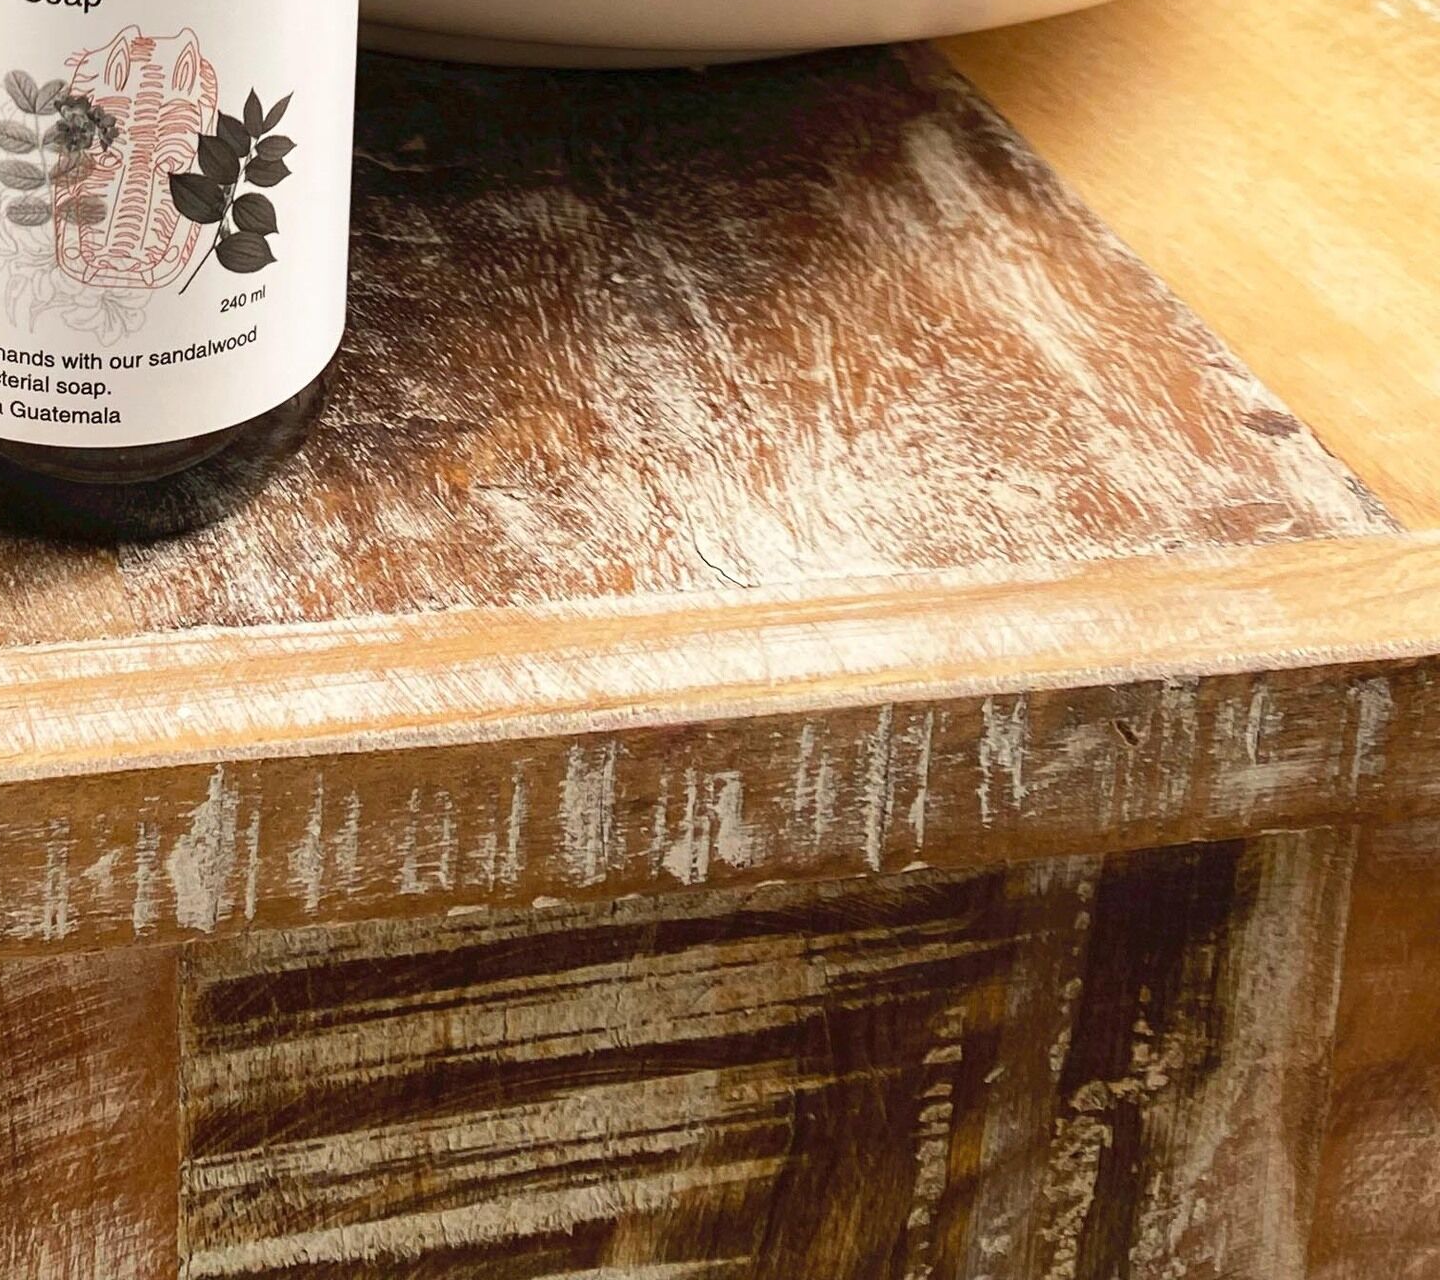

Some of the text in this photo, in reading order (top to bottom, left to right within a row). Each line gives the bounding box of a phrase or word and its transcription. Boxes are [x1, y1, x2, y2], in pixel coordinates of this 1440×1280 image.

[219, 284, 266, 313] 240 ml
[61, 352, 103, 370] with
[109, 354, 144, 370] our
[148, 324, 258, 367] sandalwood
[55, 380, 112, 400] soap.
[9, 400, 122, 425] Guatemala
